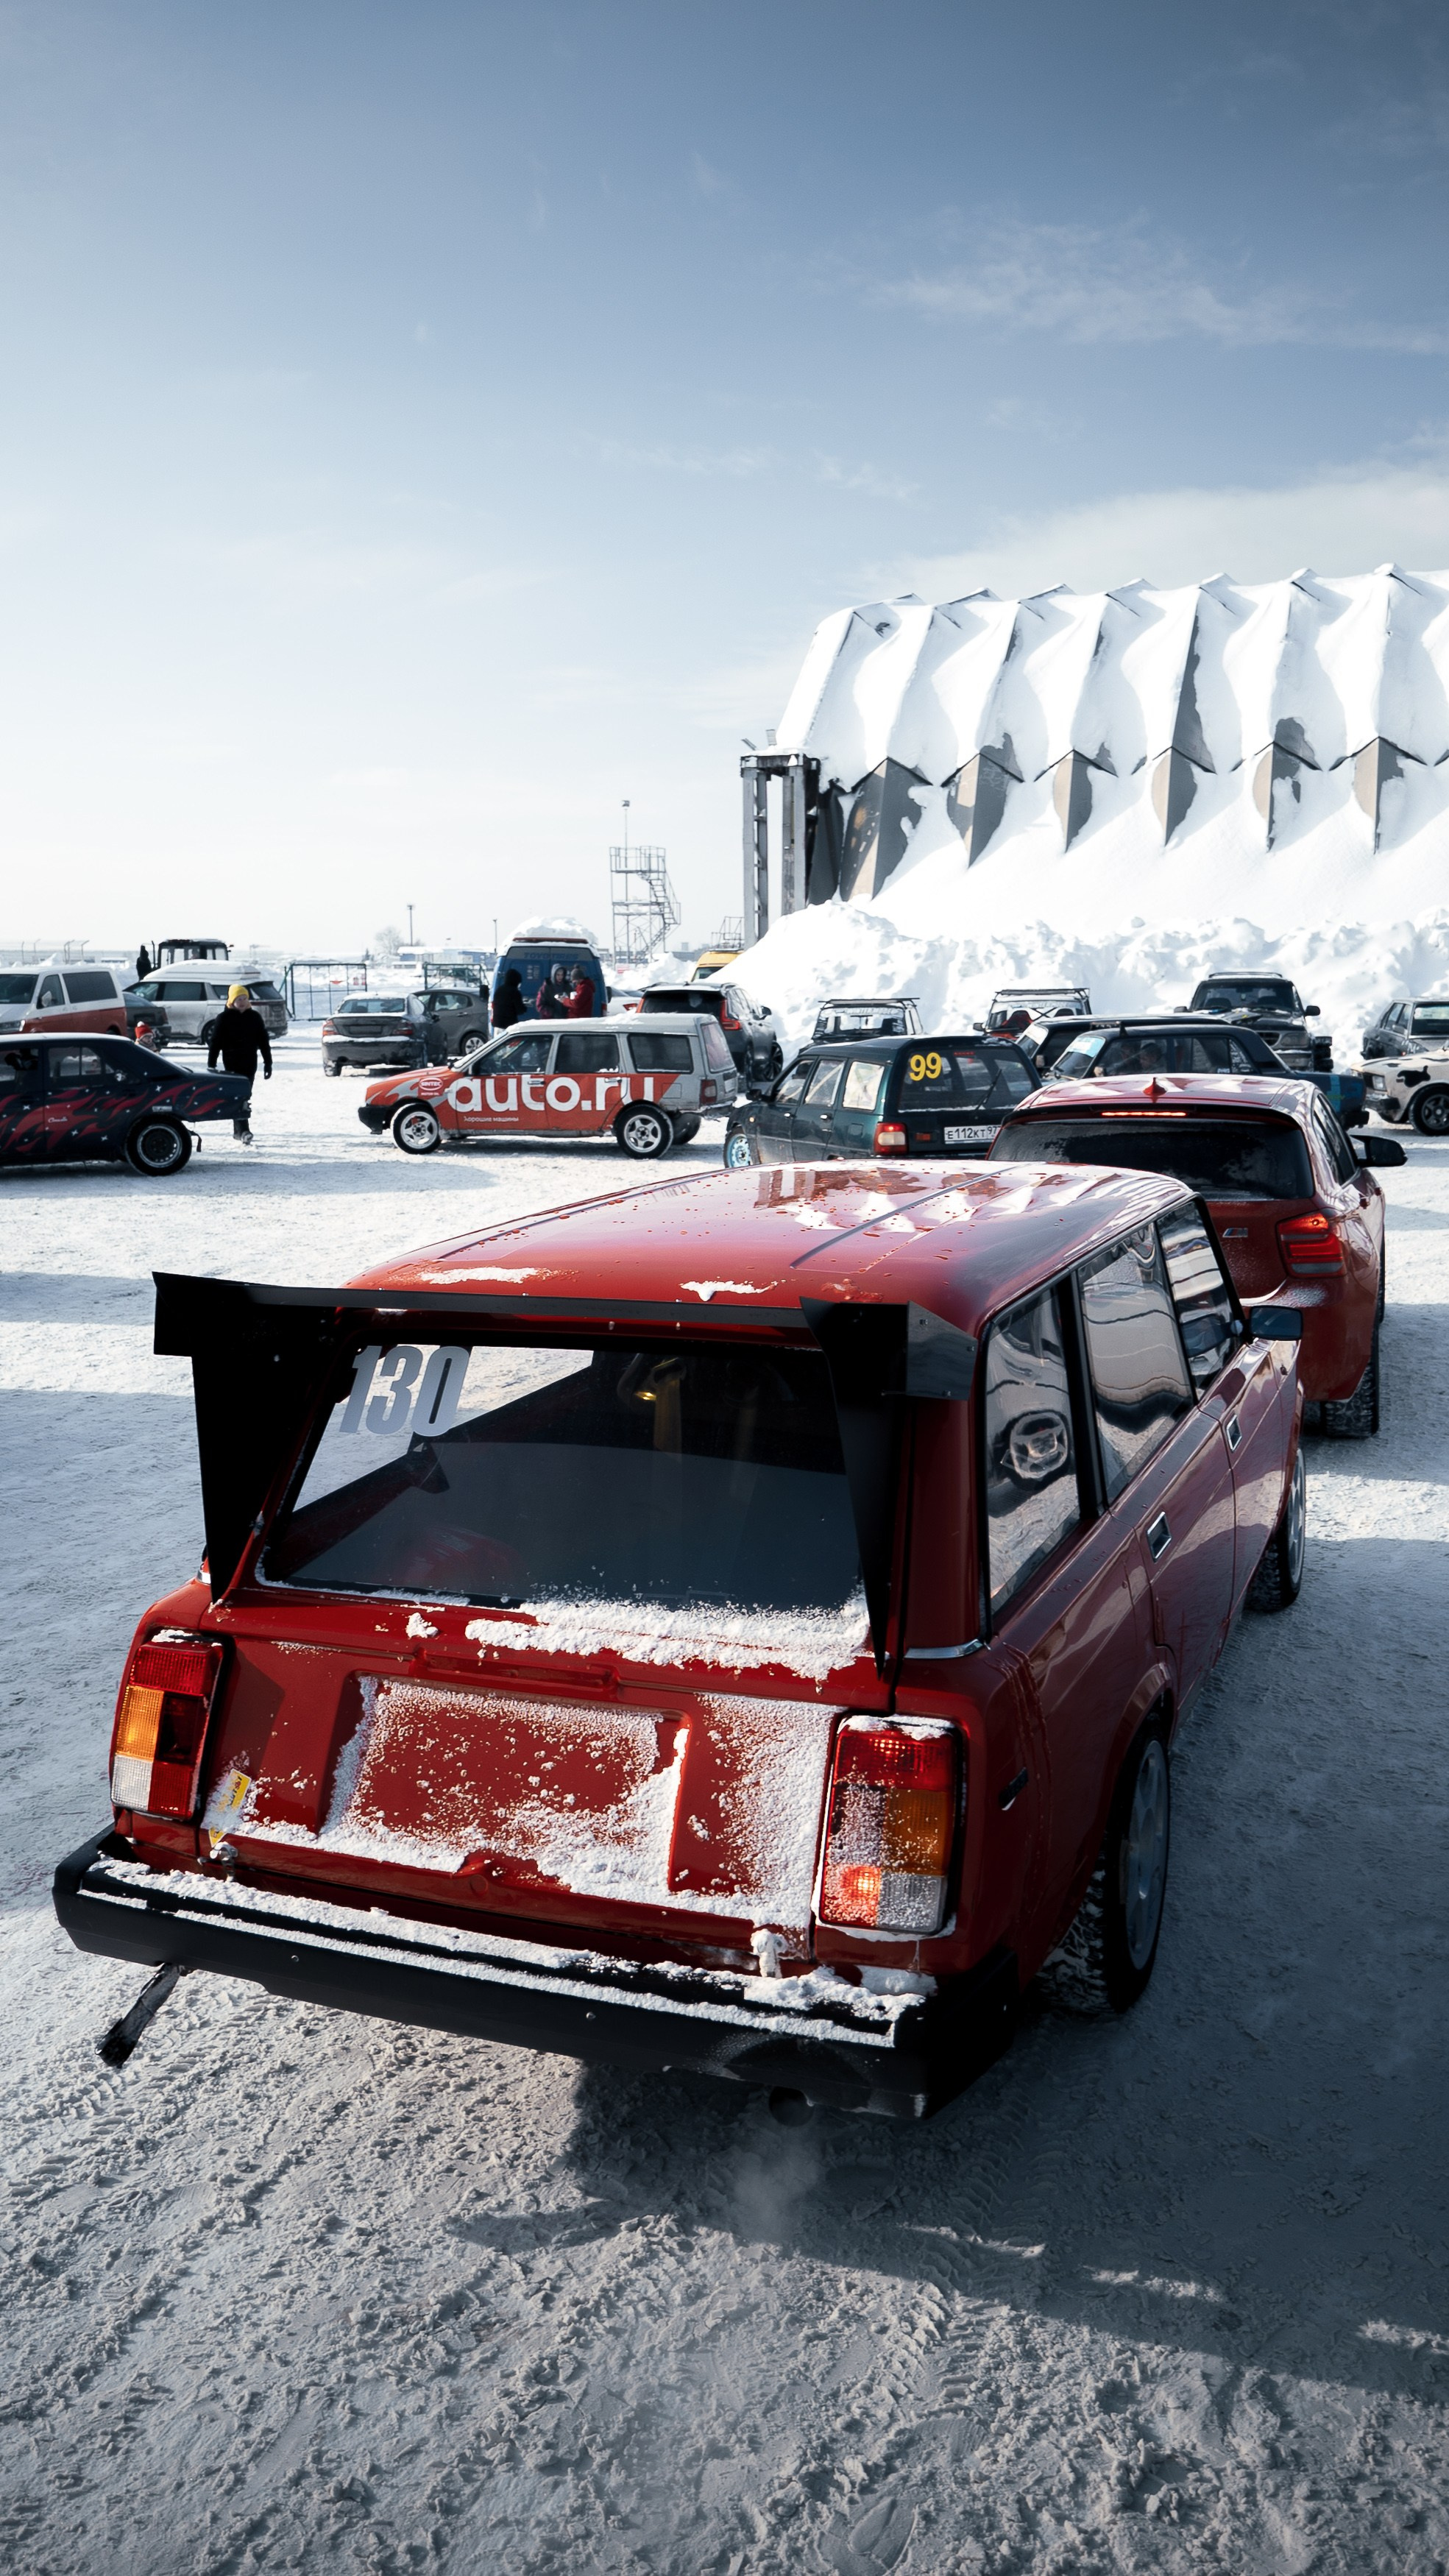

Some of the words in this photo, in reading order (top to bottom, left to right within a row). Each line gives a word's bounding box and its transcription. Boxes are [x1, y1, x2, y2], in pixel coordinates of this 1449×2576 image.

[910, 1052, 941, 1081] 99
[447, 1075, 654, 1112] auto.ru
[987, 1126, 1001, 1134] 97
[339, 1345, 470, 1437] 130
